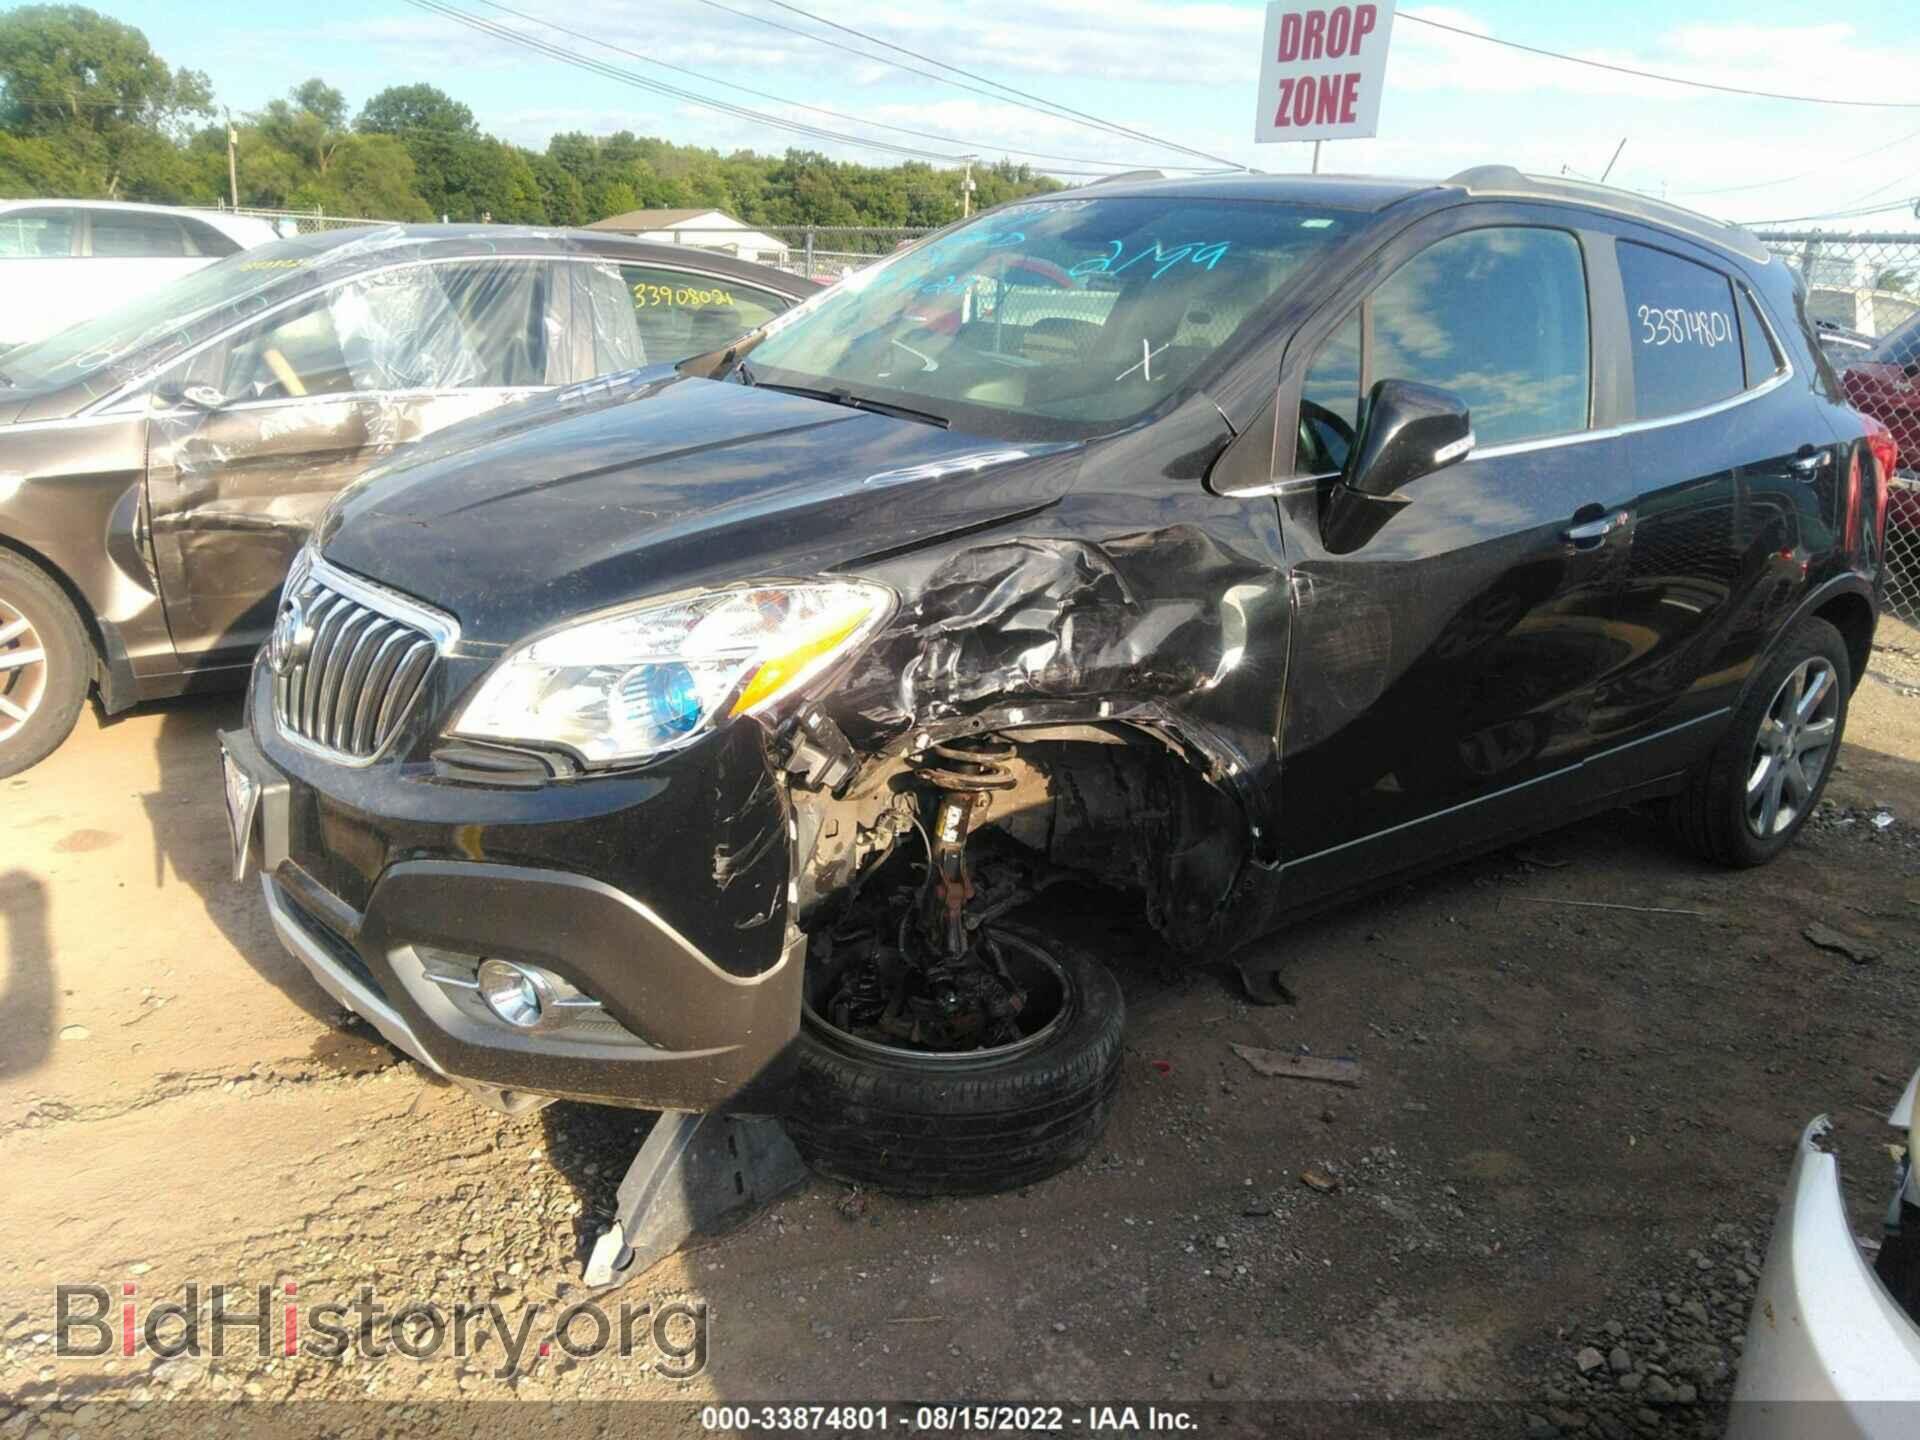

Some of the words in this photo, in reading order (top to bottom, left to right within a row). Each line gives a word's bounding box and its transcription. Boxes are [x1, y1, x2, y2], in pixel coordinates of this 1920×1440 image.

[1278, 4, 1377, 62] DROP
[1274, 73, 1361, 128] ZONE
[1638, 304, 1733, 348] 33874801
